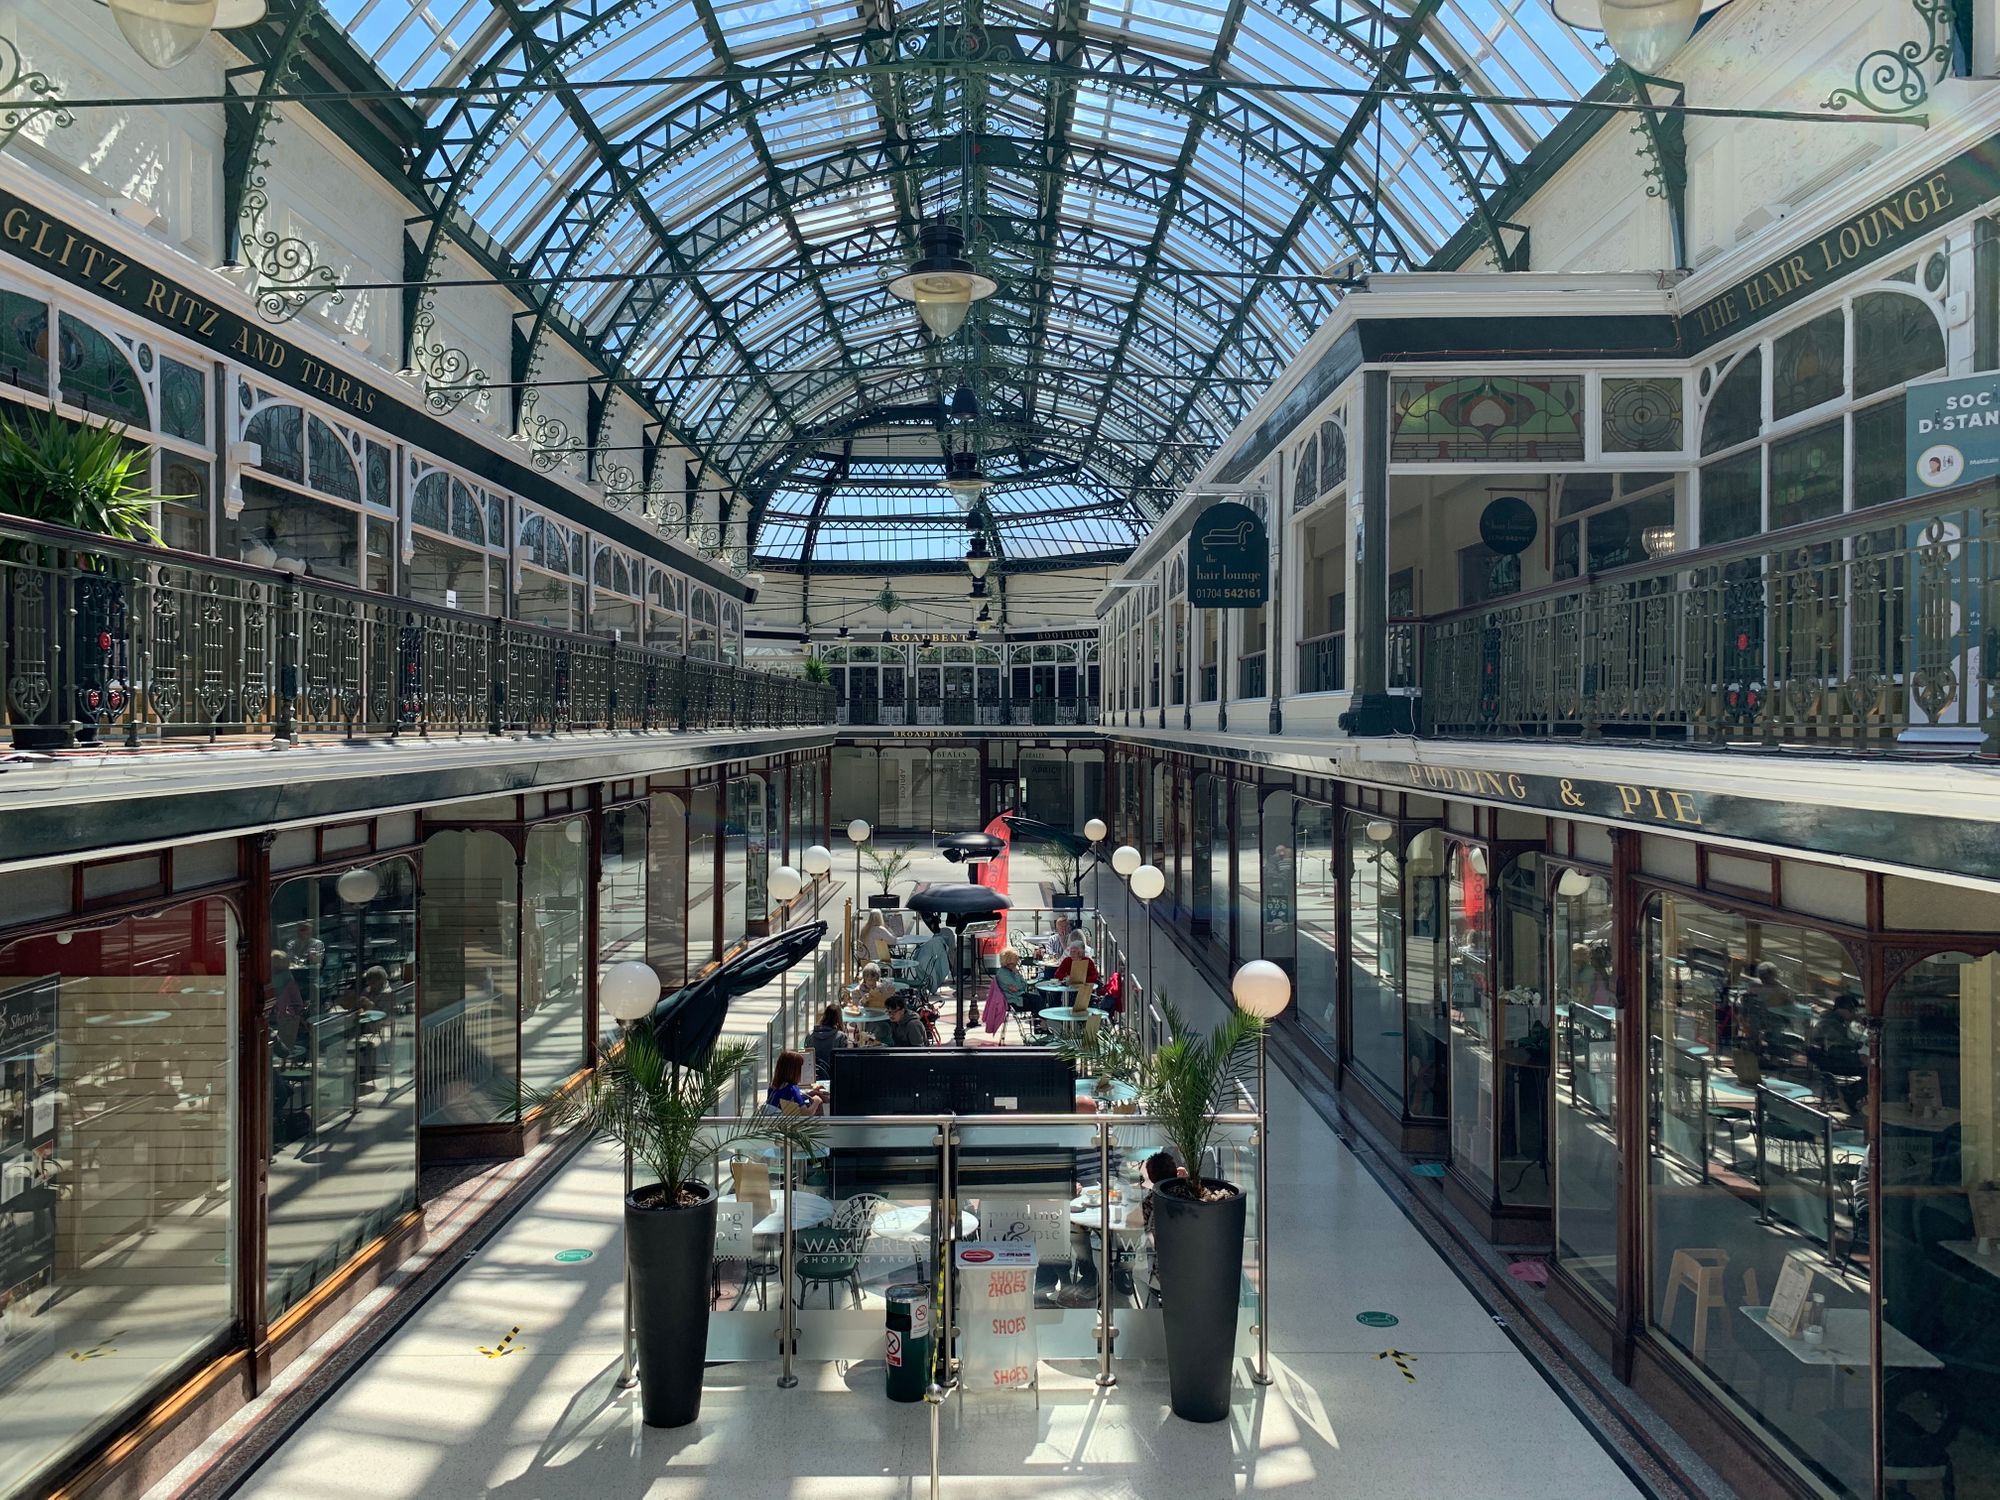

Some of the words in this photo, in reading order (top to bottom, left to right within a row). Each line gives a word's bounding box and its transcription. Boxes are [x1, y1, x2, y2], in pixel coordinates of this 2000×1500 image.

[1694, 293, 1740, 337] THE
[1743, 255, 1813, 312] HAIR
[1819, 173, 1953, 272] LOUNGE
[145, 282, 221, 337] RITZ
[230, 325, 286, 368] AND
[301, 357, 375, 413] TIARAS
[1206, 554, 1216, 563] the
[1196, 564, 1220, 580] hair
[1223, 564, 1261, 582] lounge
[1196, 588, 1221, 599] 01704
[1224, 588, 1261, 599] 542161
[881, 632, 968, 642] ROADBENT
[1036, 629, 1096, 640] BOOTHROY
[1408, 764, 1526, 800] PUDDING
[1560, 778, 1585, 807] &
[1616, 785, 1702, 825] PIE
[803, 1236, 931, 1253] WAYFARERS
[803, 1255, 870, 1264] SHOPPING
[992, 1316, 1026, 1335] SHOES
[993, 1366, 1029, 1384] SHOES
